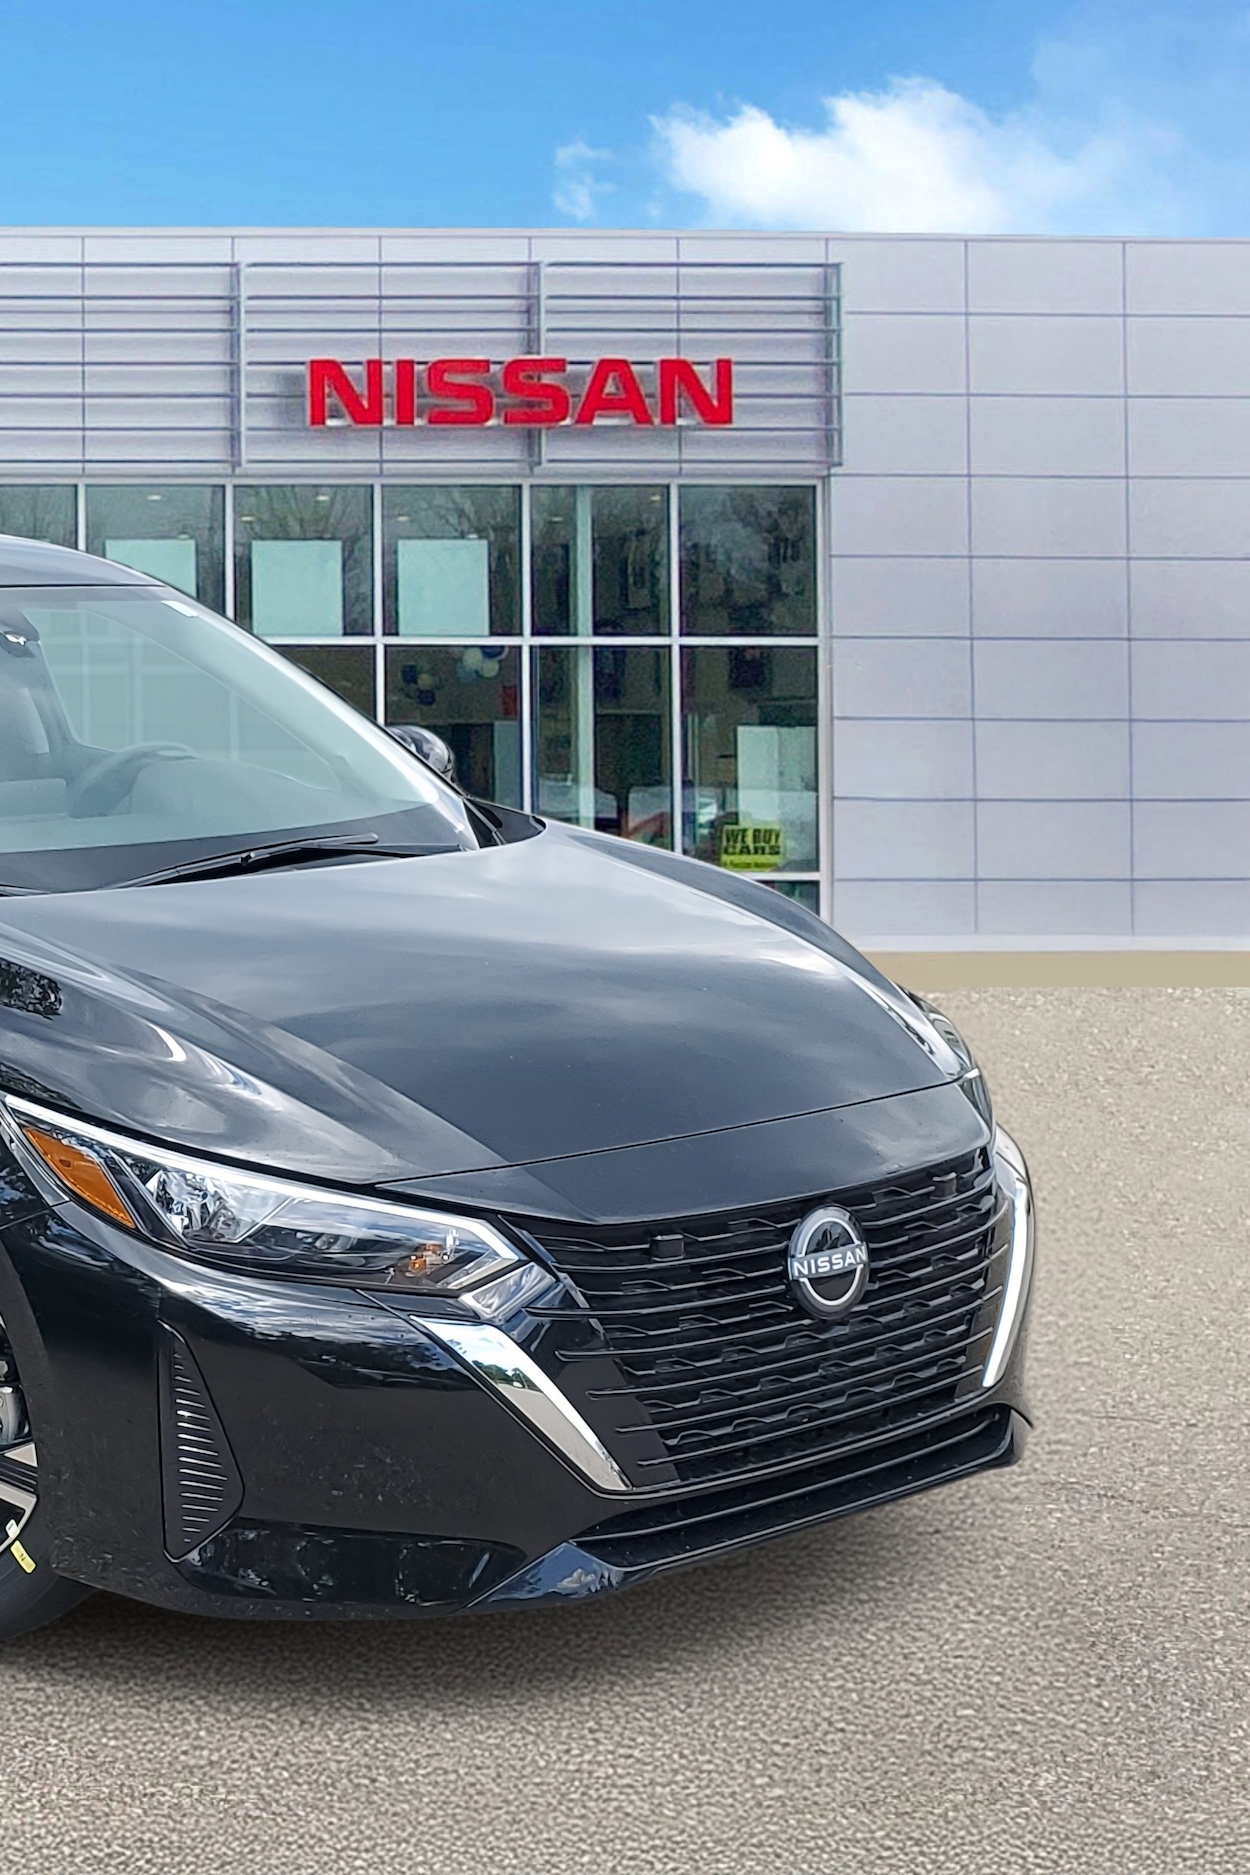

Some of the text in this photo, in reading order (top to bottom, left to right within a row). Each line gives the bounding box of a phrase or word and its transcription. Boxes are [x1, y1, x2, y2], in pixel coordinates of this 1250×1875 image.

[307, 357, 734, 426] NISSAN
[724, 828, 782, 845] WE BUY
[723, 844, 782, 856] CARS
[793, 1245, 867, 1277] NISSAN
